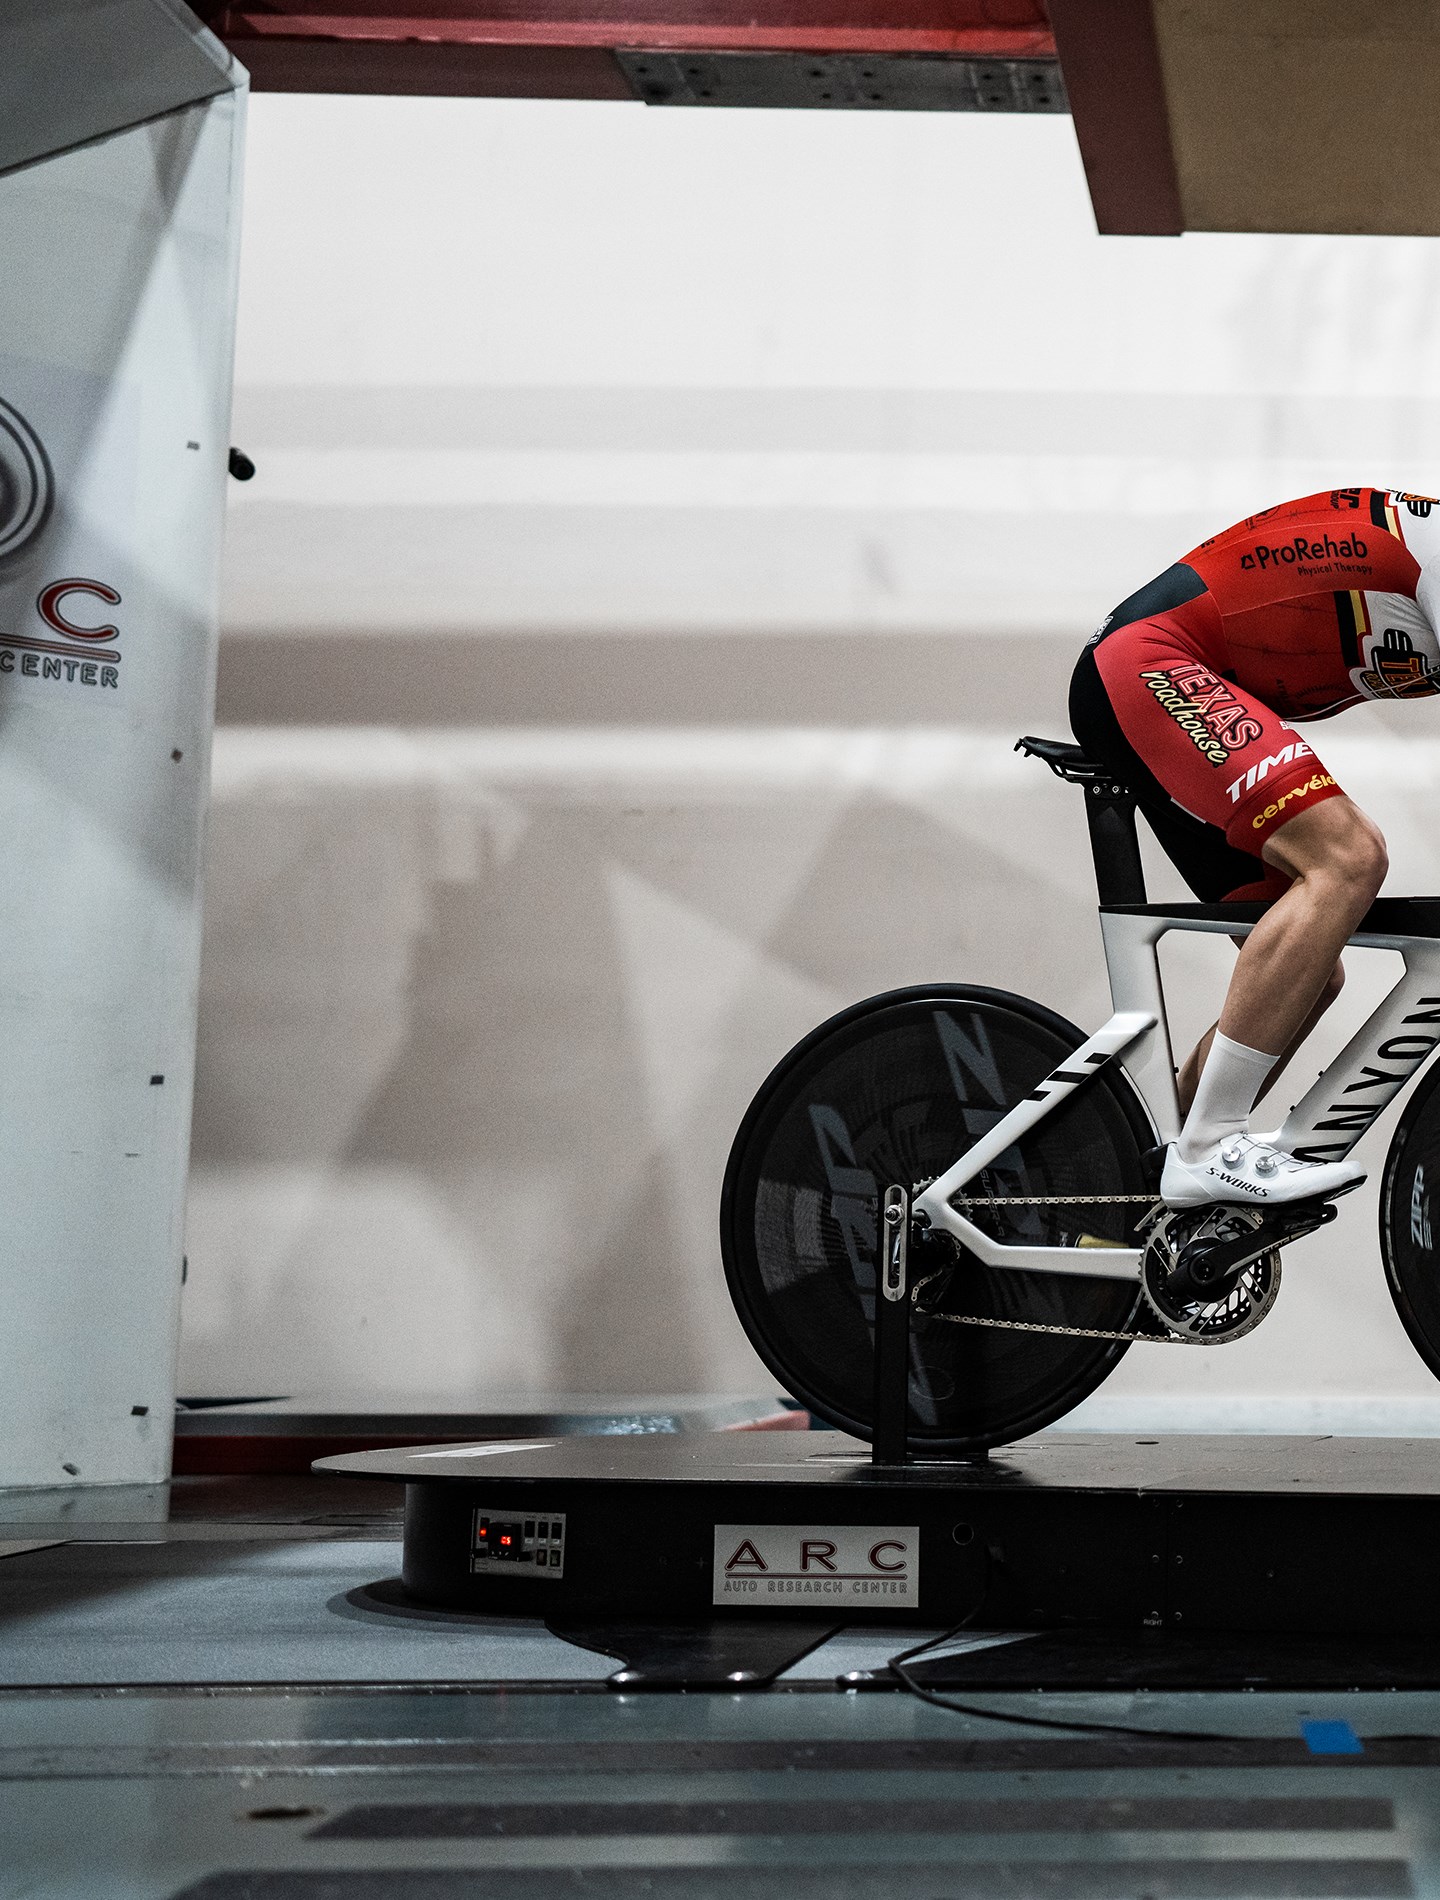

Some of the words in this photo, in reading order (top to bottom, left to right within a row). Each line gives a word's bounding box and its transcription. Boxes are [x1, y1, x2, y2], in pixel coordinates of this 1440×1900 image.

[1255, 532, 1368, 570] ProRehab
[1297, 565, 1333, 577] Physical
[1335, 562, 1373, 577] Therapy
[36, 577, 121, 643] C
[0, 650, 119, 689] CENTER
[1139, 670, 1230, 767] roadhouse
[1167, 662, 1263, 749] TEXAS
[1226, 741, 1315, 804] TIME
[1205, 1166, 1271, 1198] S-WORKS
[1410, 1163, 1425, 1249] ZIPP
[724, 1580, 758, 1593] AUTO
[767, 1580, 843, 1594] RESEARCH
[852, 1581, 908, 1594] CENTER
